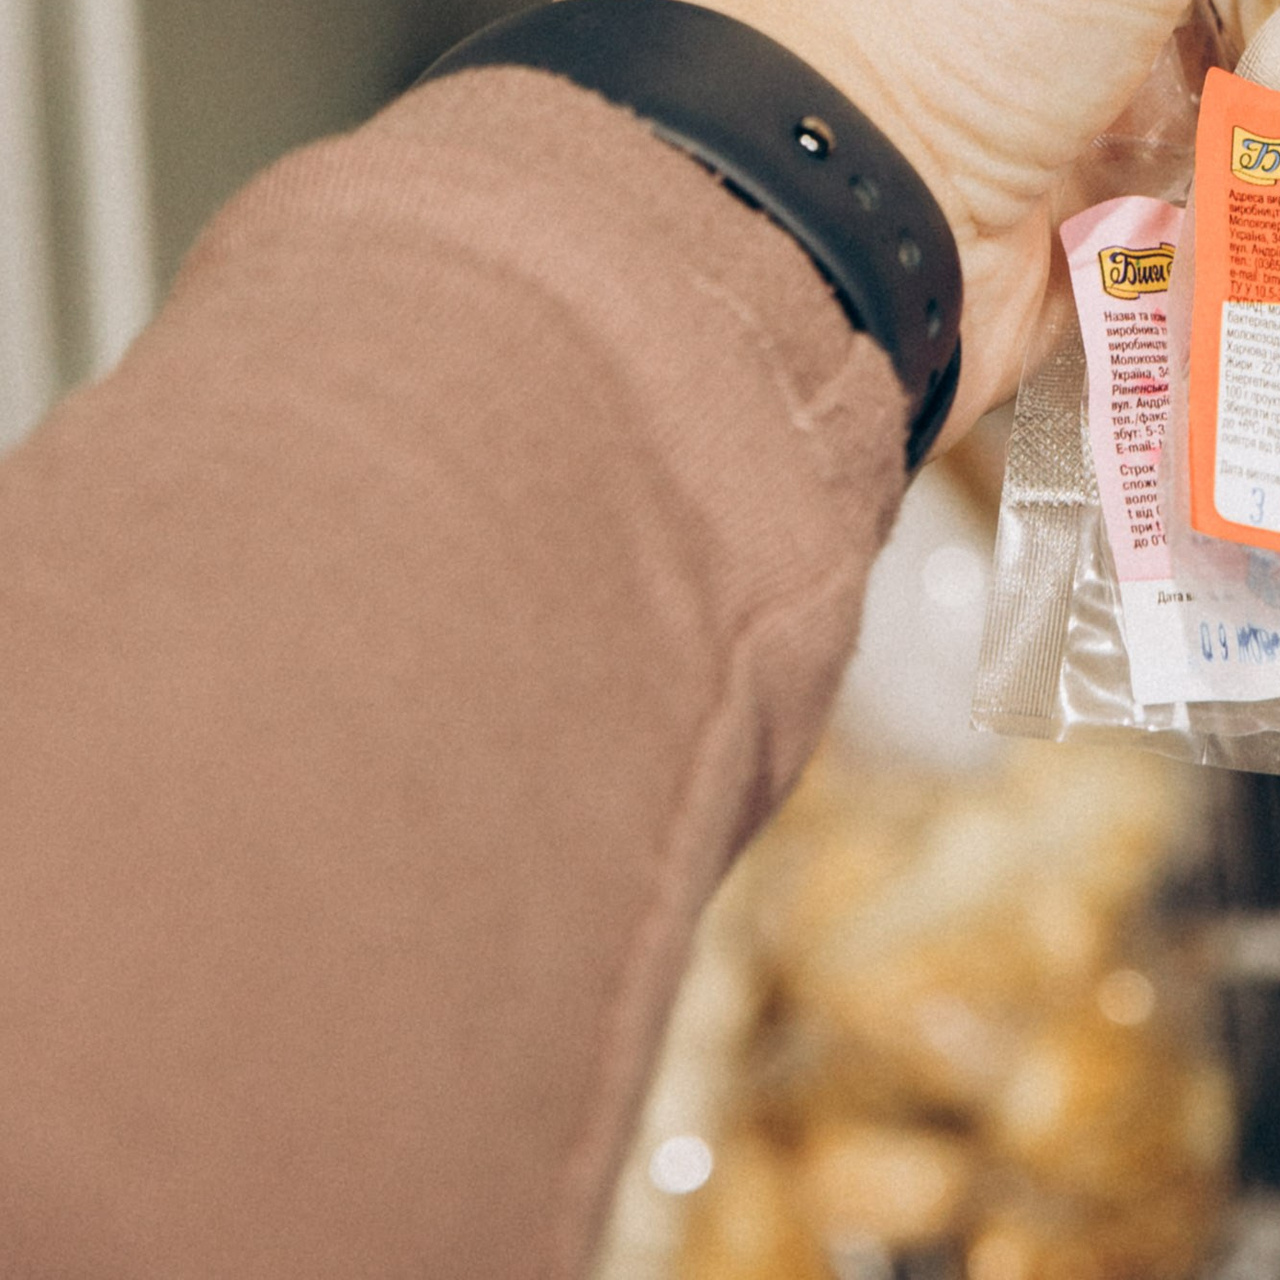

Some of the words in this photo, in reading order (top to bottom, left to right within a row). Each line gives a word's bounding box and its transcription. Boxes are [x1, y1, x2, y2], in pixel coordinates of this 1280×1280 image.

[1229, 189, 1264, 204] Адреса
[1104, 310, 1136, 322] Назва
[1138, 312, 1149, 322] та
[1106, 323, 1159, 338] виробника
[1112, 367, 1155, 383] Україна,
[1111, 400, 1133, 413] вул.
[1111, 411, 1168, 426] тел./факс
[1115, 440, 1155, 455] E-mail:
[1120, 464, 1156, 477] Строк
[1135, 505, 1154, 519] від
[1130, 523, 1153, 536] при
[1133, 538, 1148, 550] до
[1157, 589, 1184, 605] Дата
